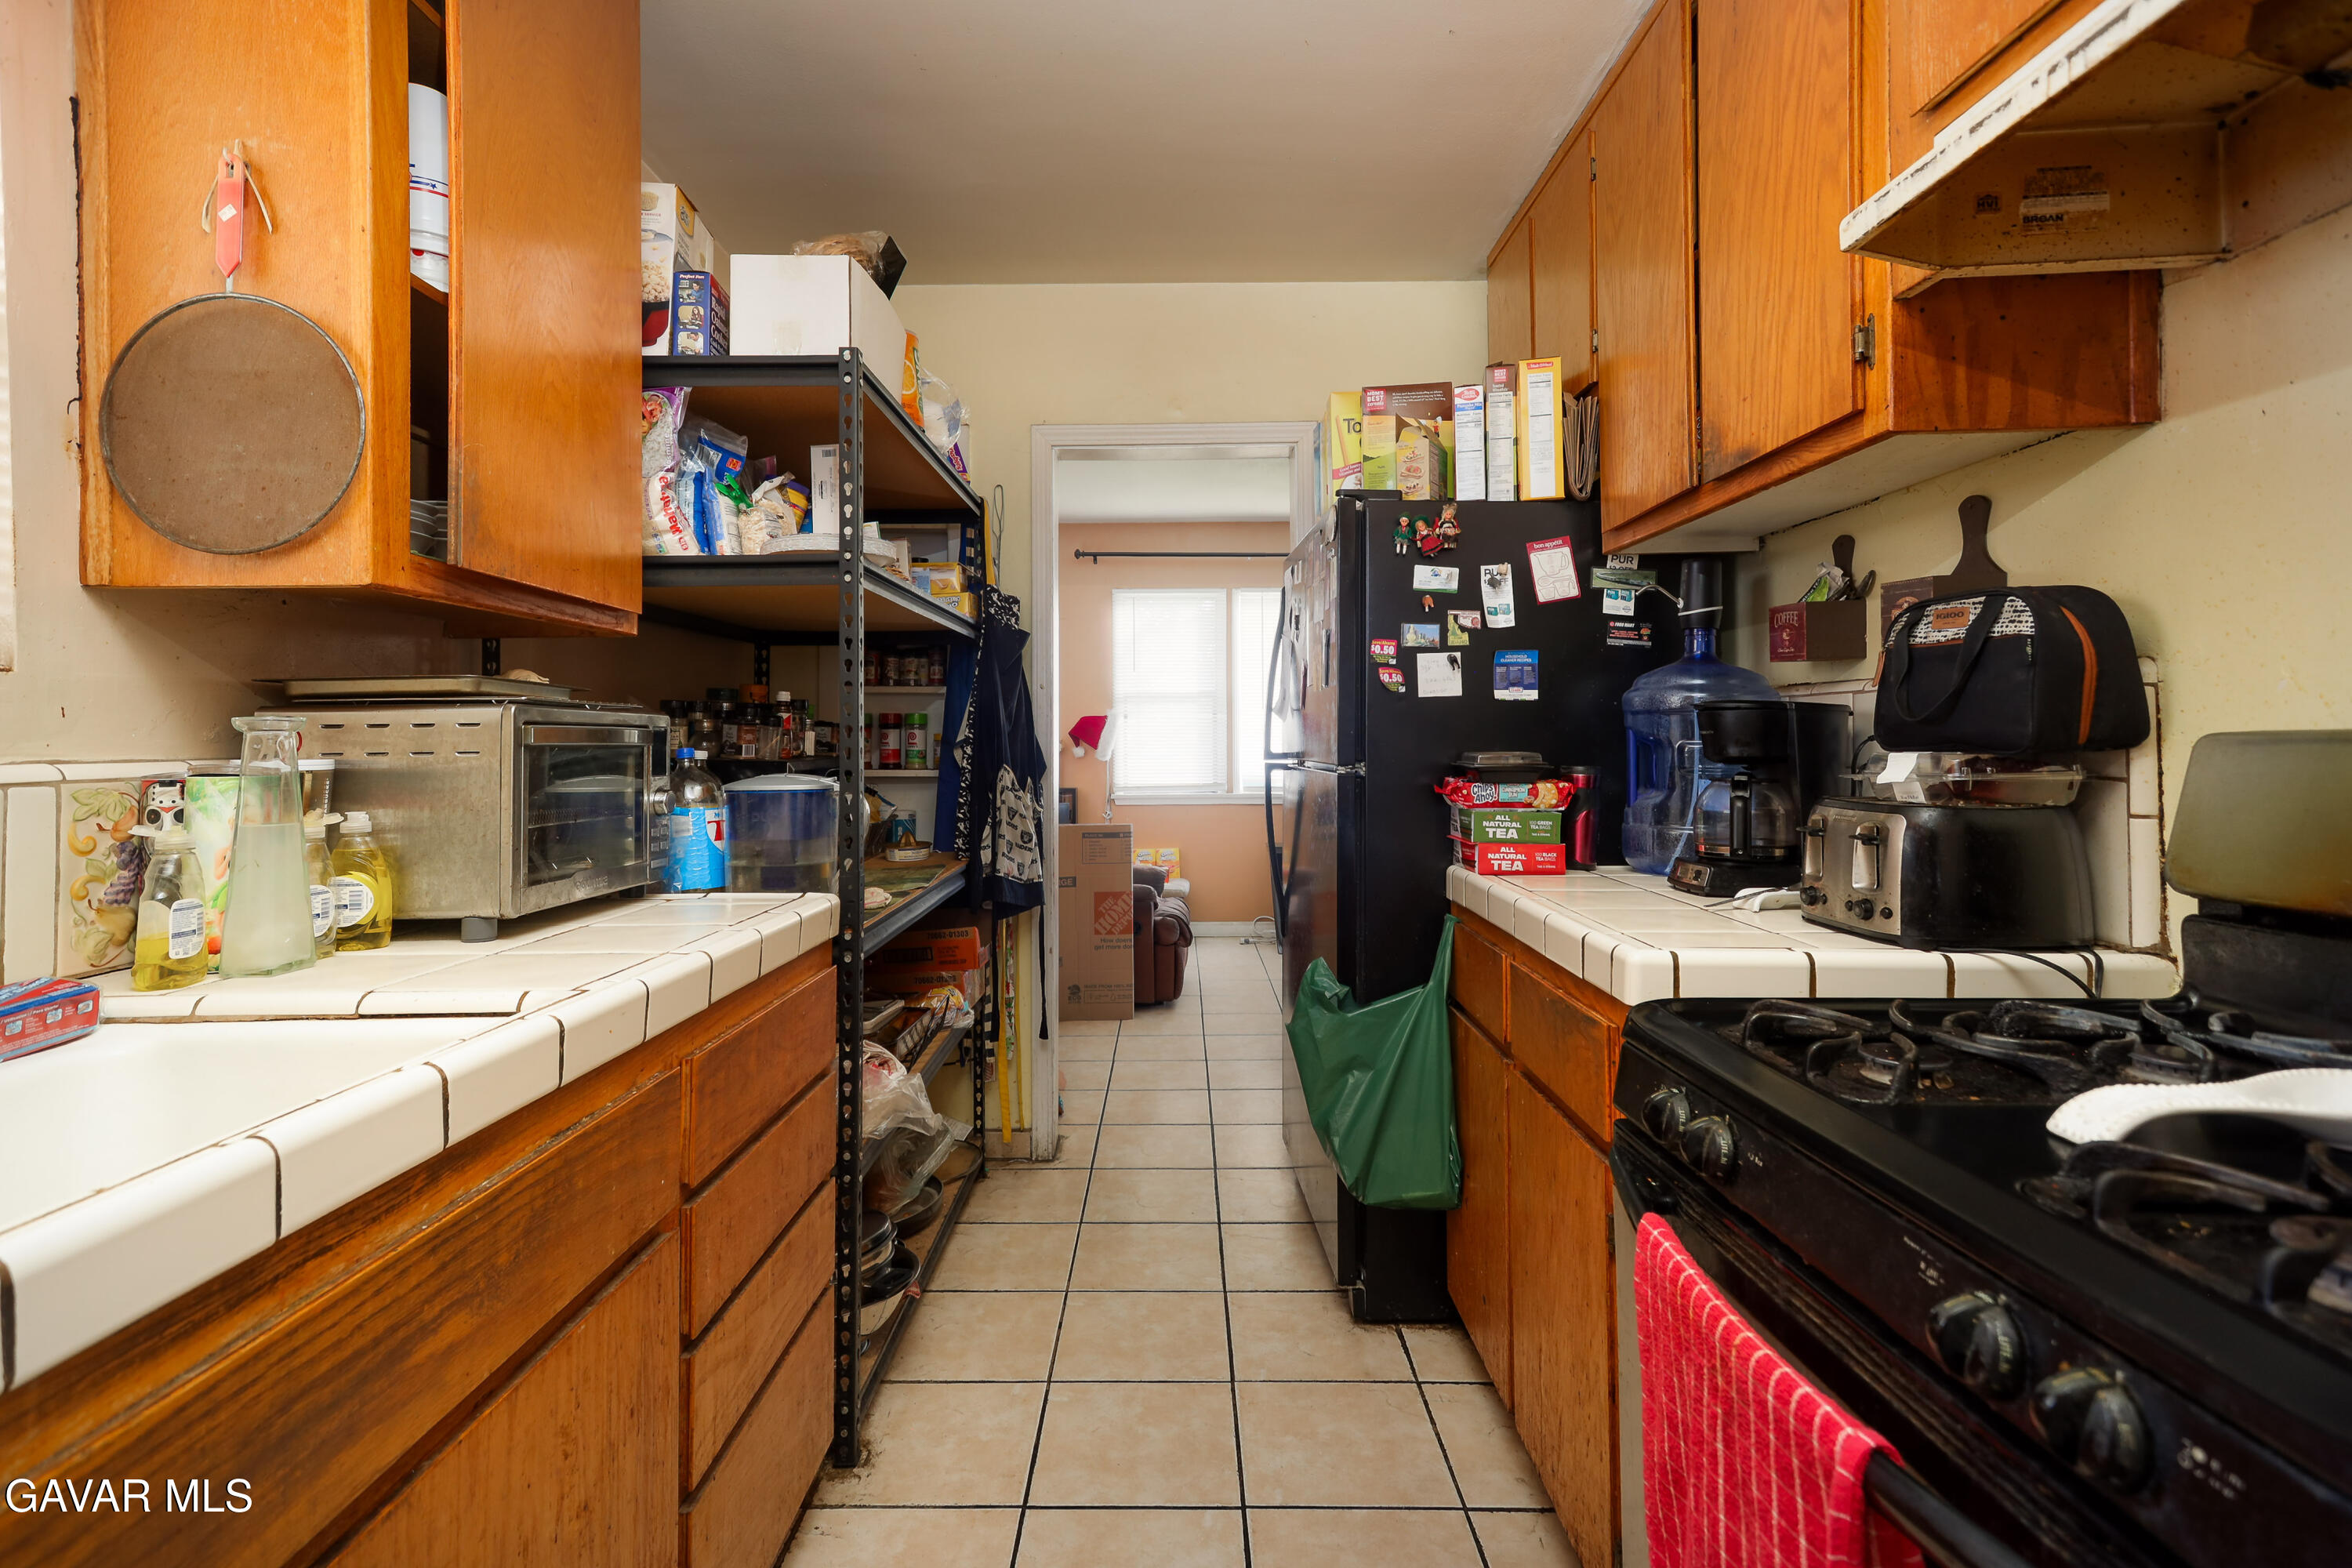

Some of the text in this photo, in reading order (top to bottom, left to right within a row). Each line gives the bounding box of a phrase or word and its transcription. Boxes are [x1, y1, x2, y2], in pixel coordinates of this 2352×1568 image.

[2023, 214, 2064, 224] BROAN
[1610, 554, 1634, 564] PUR
[1774, 611, 1798, 628] COFFEE
[1936, 611, 1965, 620] IGLOO
[1371, 645, 1395, 655] $0.50
[1379, 673, 1403, 682] $0.50
[1472, 783, 1494, 795] Chips
[1475, 789, 1498, 803] Ahoy!
[1485, 828, 1519, 839] TEA
[1490, 860, 1524, 871] TEA
